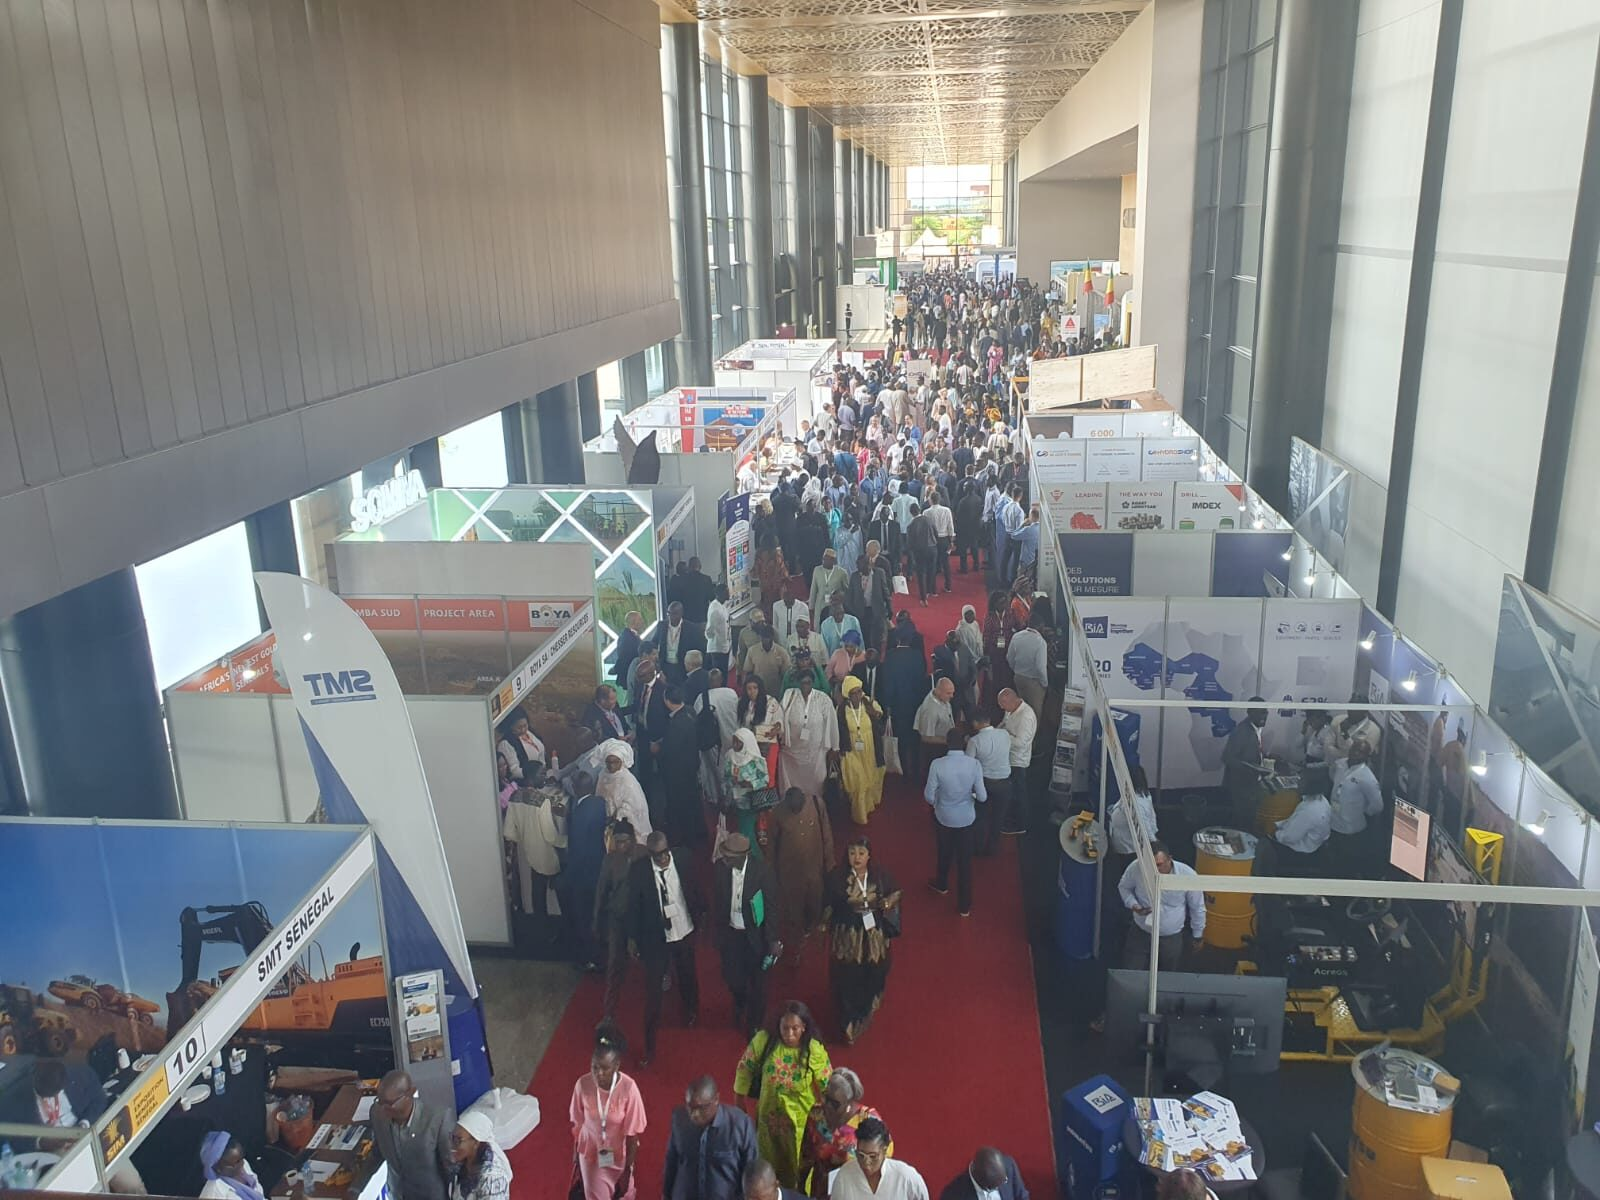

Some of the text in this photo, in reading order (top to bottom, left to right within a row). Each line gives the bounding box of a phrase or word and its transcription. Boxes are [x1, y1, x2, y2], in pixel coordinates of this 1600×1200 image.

[1084, 585, 1120, 593] MESURE
[355, 608, 400, 617] MBA SUD
[424, 609, 495, 617] PROJECT AREA
[515, 676, 522, 691] 9
[173, 886, 335, 1075] 10 SMT SÉNÉGAL
